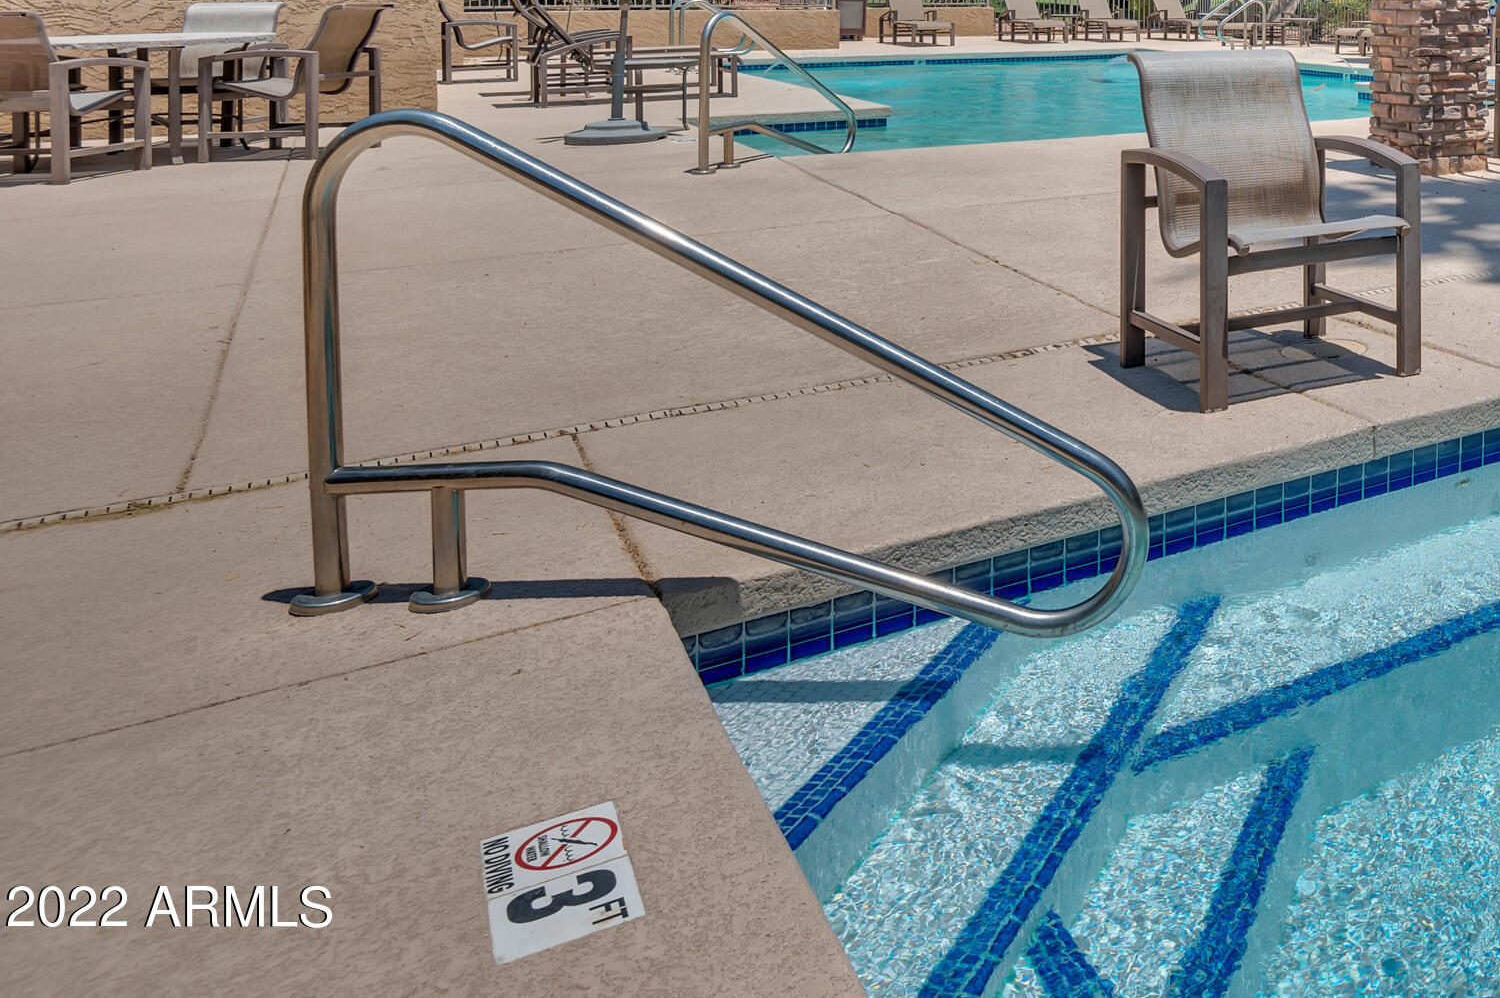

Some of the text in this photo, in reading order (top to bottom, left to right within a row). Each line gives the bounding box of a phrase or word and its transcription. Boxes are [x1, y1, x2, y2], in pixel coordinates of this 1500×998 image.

[482, 836, 515, 895] NO DIVING
[506, 868, 630, 925] 3 FT
